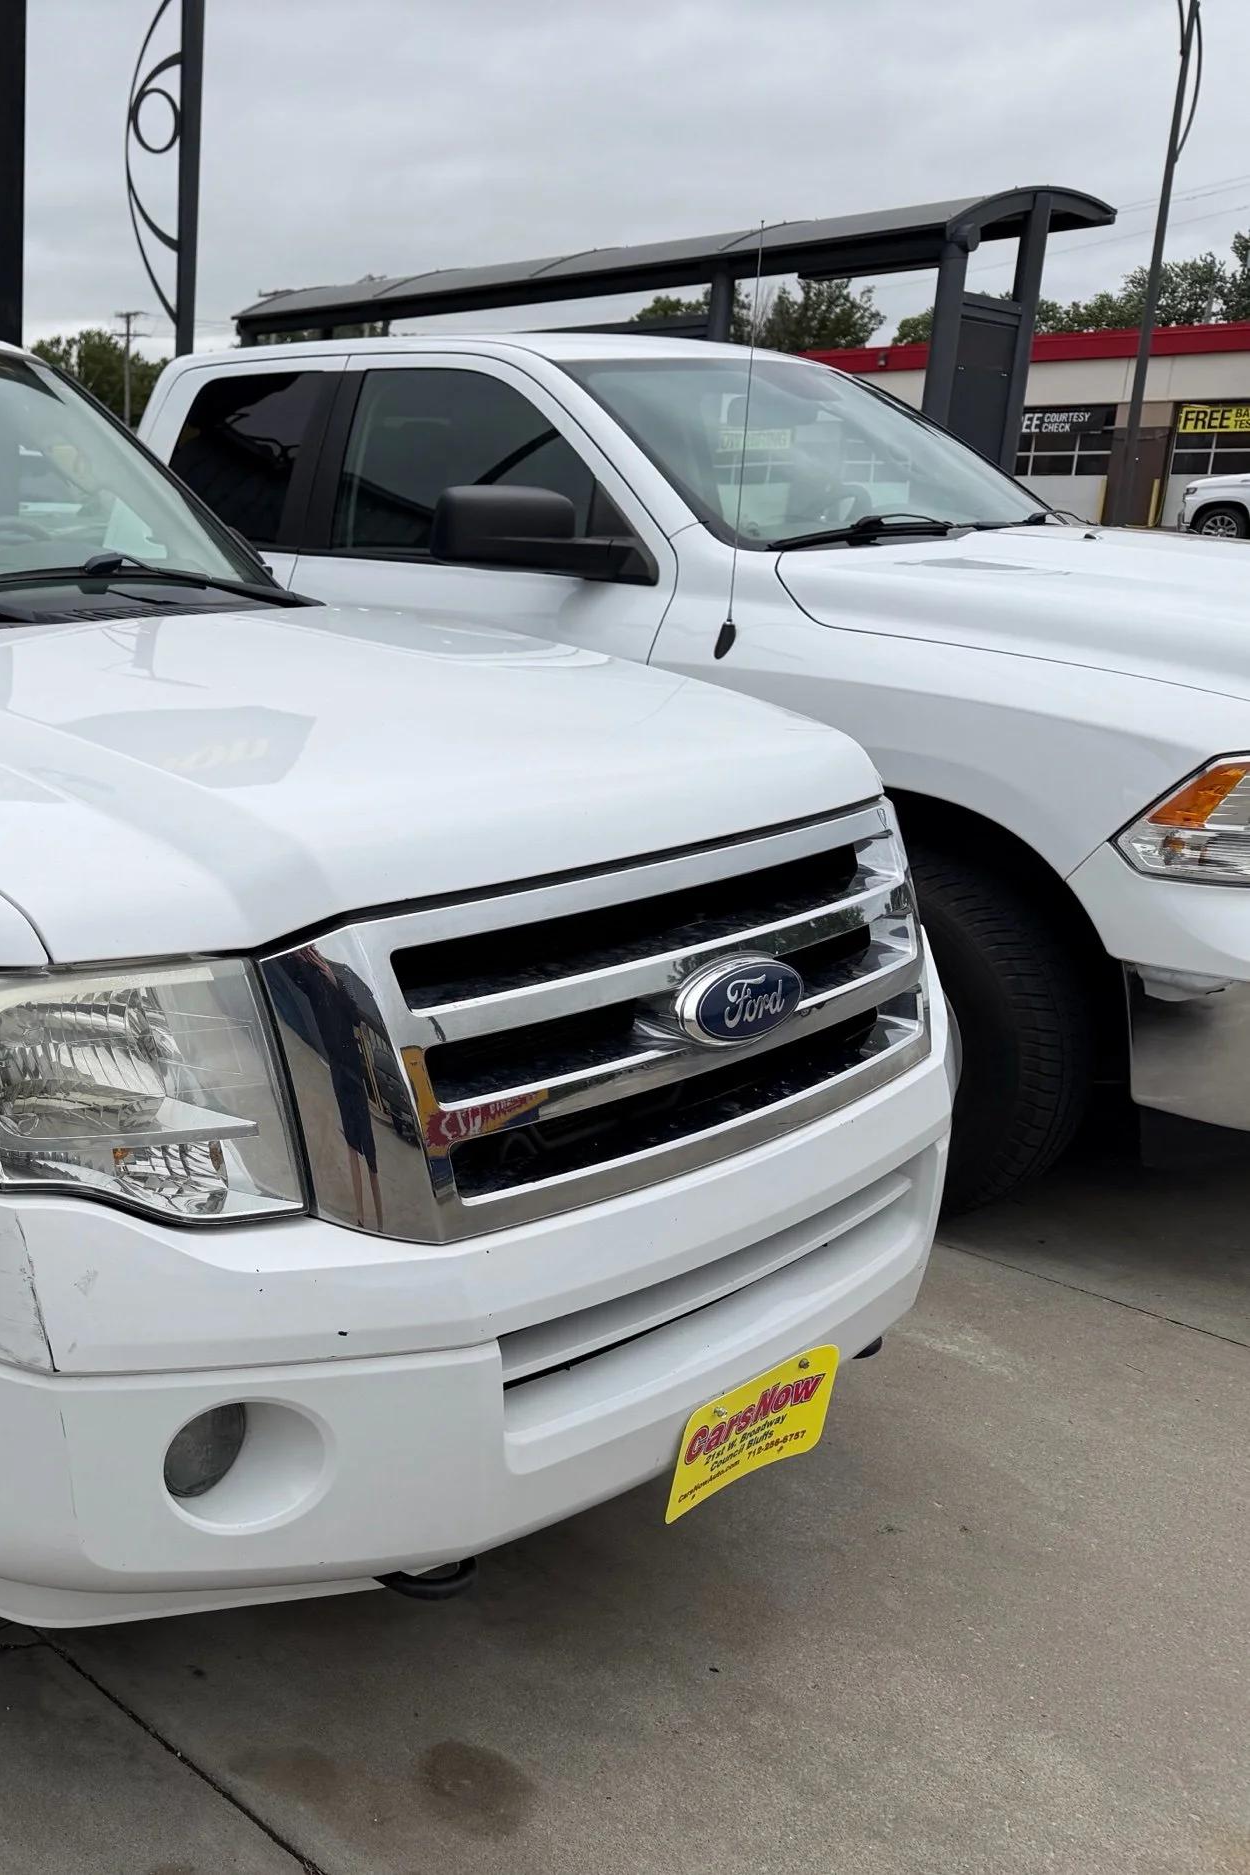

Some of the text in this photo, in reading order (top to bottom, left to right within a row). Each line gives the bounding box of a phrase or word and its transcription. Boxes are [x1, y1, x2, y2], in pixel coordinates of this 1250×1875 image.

[1021, 411, 1091, 433] EE COURTESY
[1041, 422, 1071, 433] CHECK
[1182, 409, 1233, 430] FREE
[724, 974, 785, 1028] Ford
[684, 1373, 826, 1466] CarsNow
[739, 1413, 787, 1444] Broadway
[710, 1429, 774, 1472] Council Bluffs
